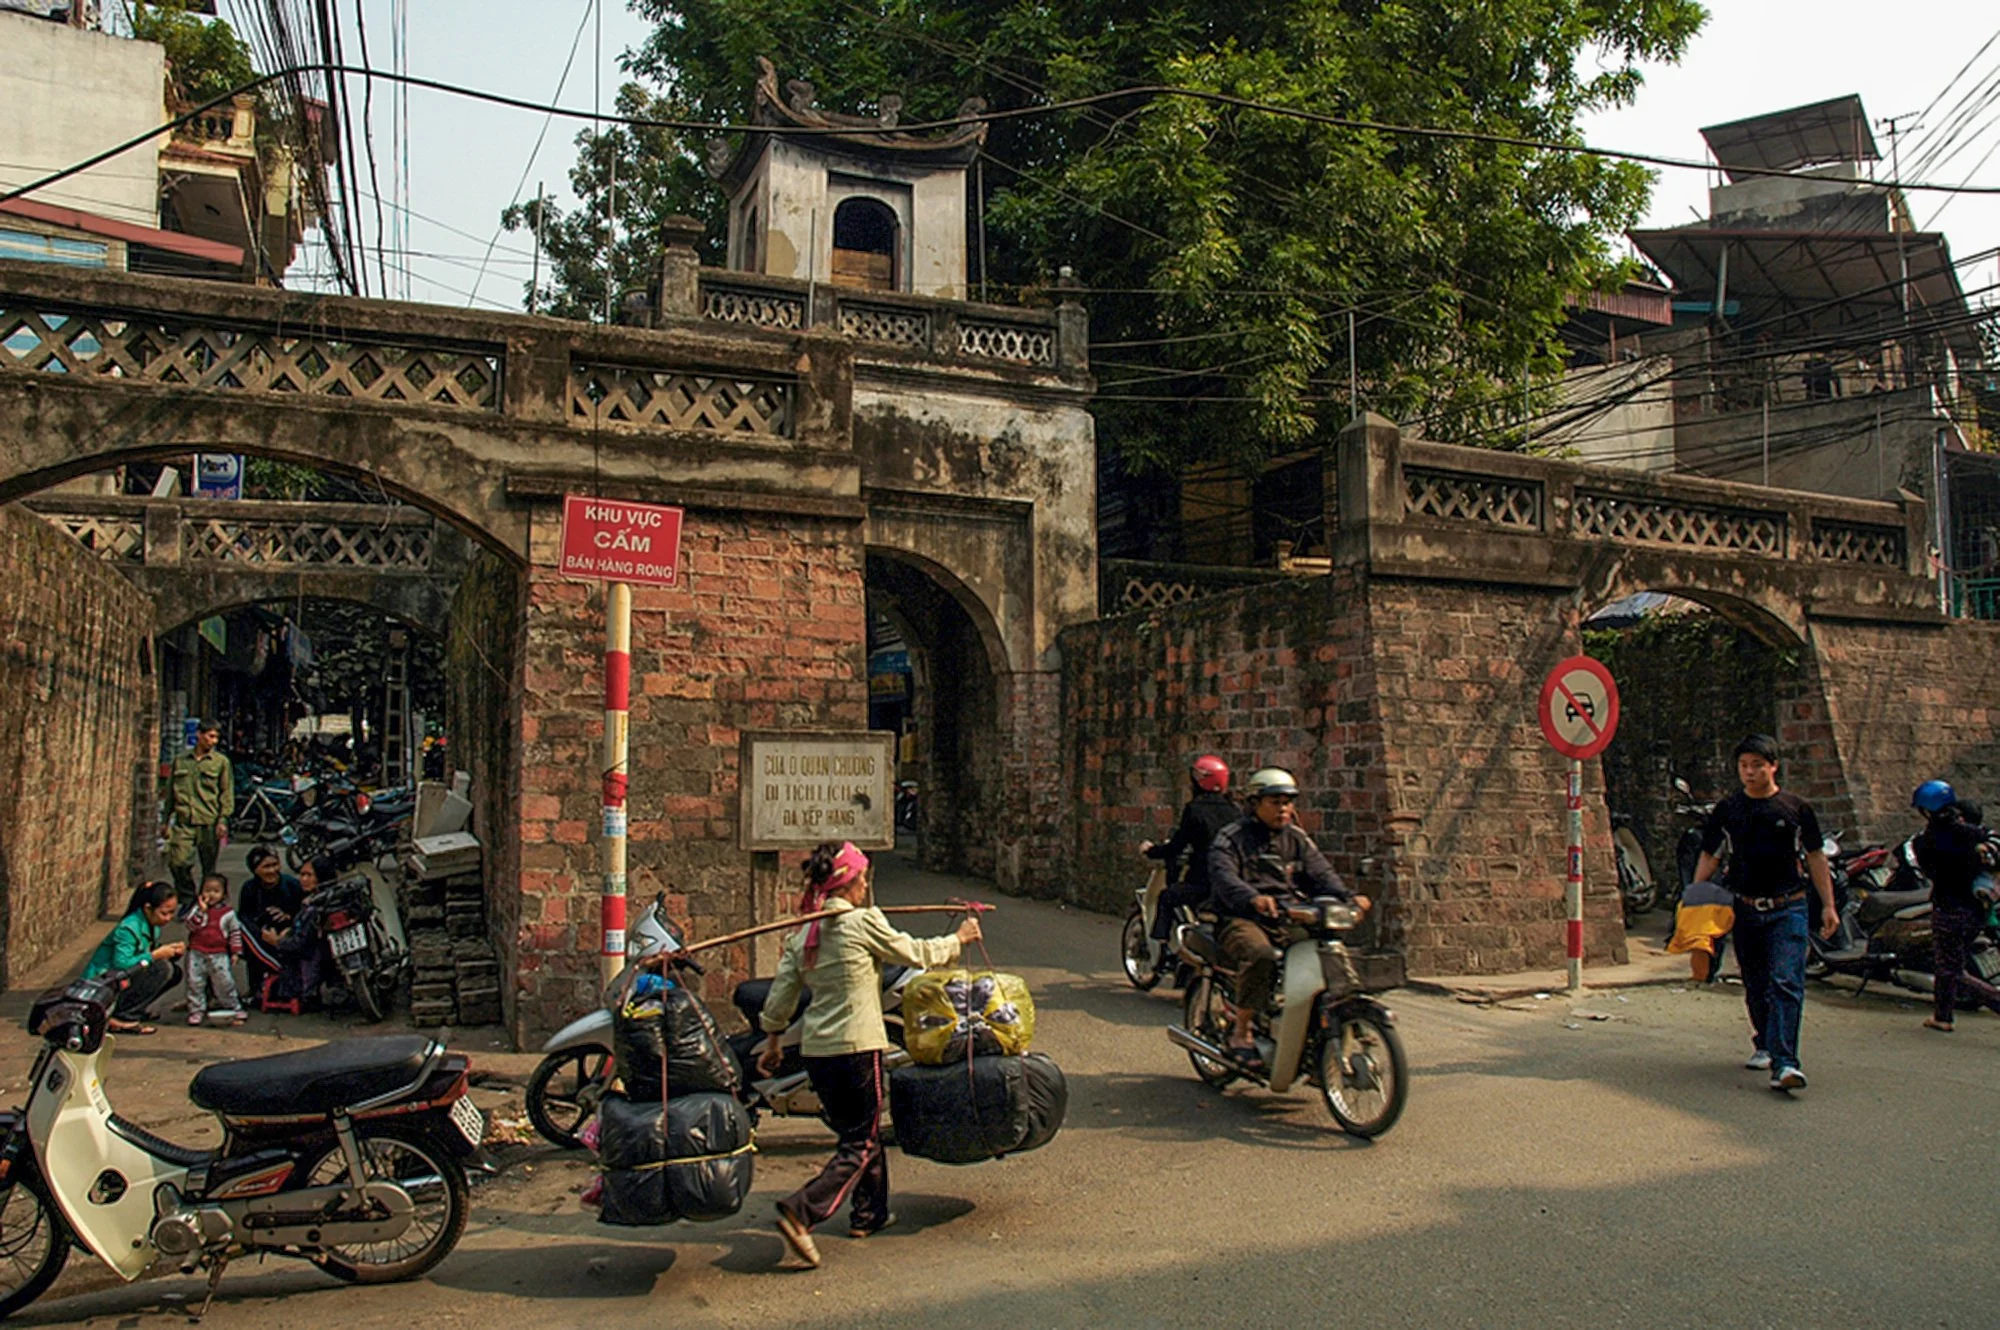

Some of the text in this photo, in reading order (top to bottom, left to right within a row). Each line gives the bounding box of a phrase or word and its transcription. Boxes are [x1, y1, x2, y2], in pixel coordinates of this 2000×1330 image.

[585, 505, 662, 529] KHU VỰC
[594, 528, 651, 553] CẤM
[566, 553, 673, 579] BÁN HÀNG RONG
